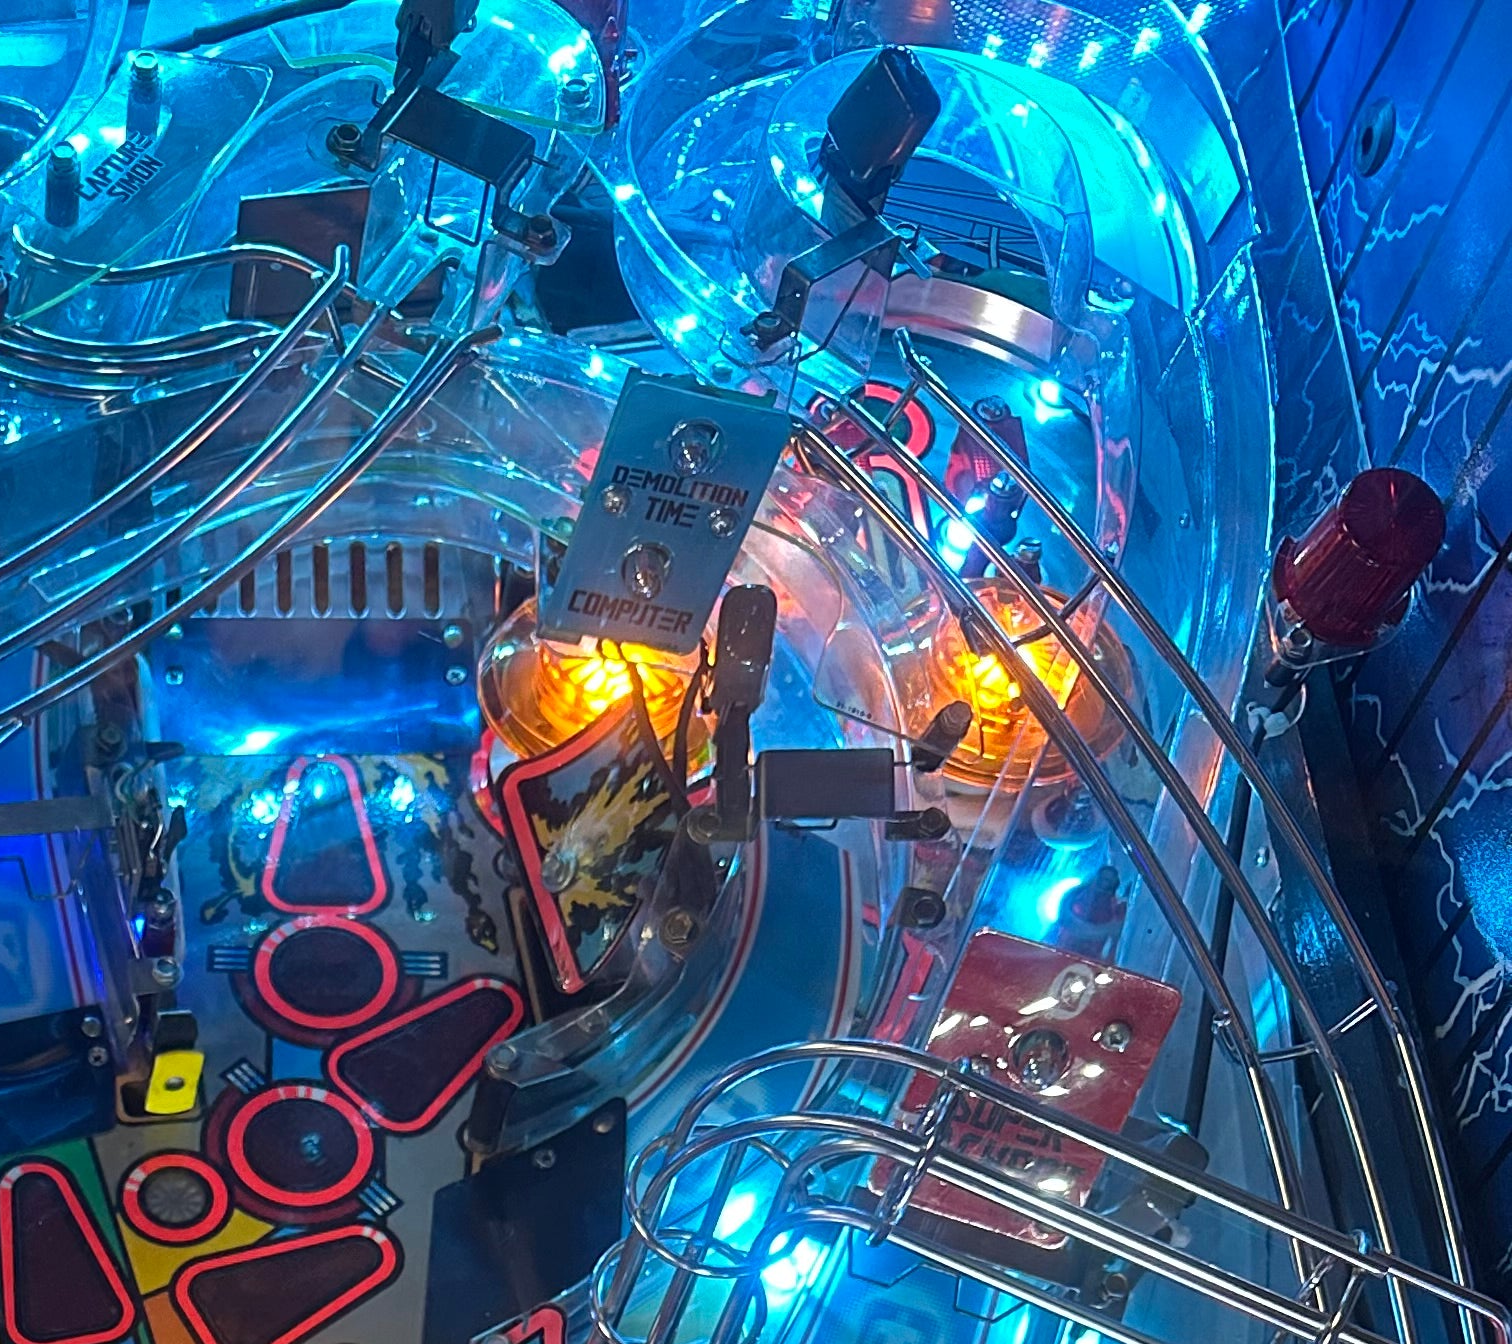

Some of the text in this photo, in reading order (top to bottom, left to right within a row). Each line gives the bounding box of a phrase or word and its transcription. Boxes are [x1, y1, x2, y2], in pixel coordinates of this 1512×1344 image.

[74, 133, 153, 201] CAPTURE
[106, 154, 165, 203] SIMON
[612, 465, 749, 507] DEMOLITION
[645, 498, 699, 529] TIME
[568, 589, 693, 635] COMPUTER
